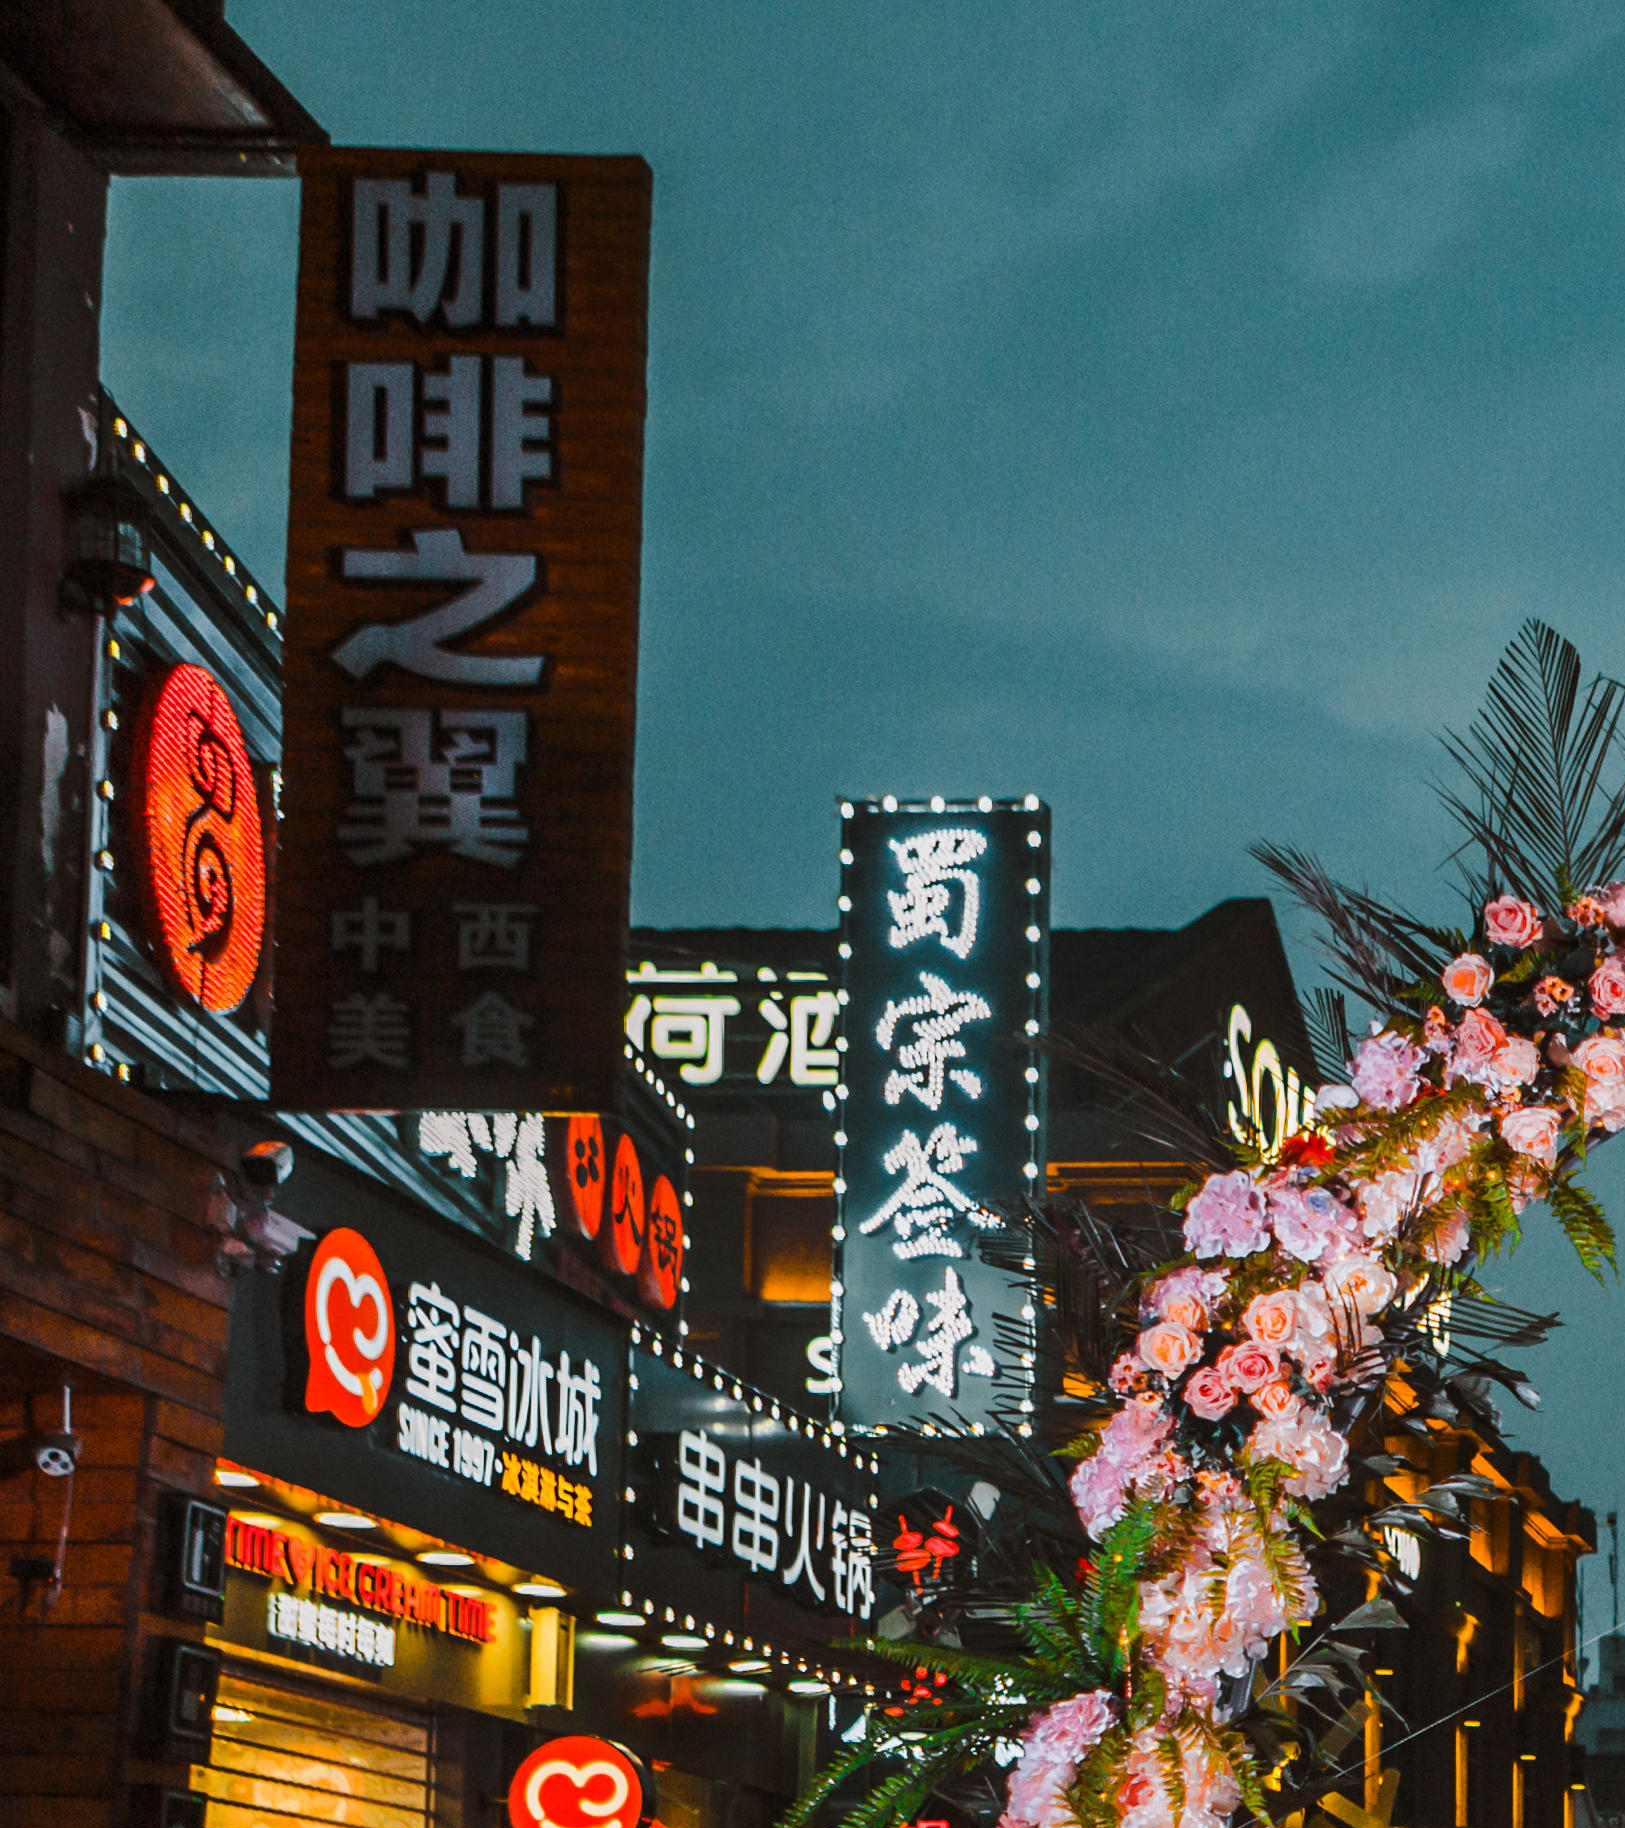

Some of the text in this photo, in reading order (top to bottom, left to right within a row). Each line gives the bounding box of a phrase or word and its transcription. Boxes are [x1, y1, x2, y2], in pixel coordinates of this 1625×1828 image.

[330, 172, 562, 868] 咖啡之翼
[862, 827, 1005, 1400] 蜀宗签味
[397, 1402, 450, 1469] SINCE
[405, 1281, 601, 1477] 蜜雪冰城
[315, 1543, 354, 1597] ICE
[358, 1560, 442, 1622] CREAM
[447, 1590, 497, 1644] TIME
[677, 1429, 872, 1619] 串串火锅
